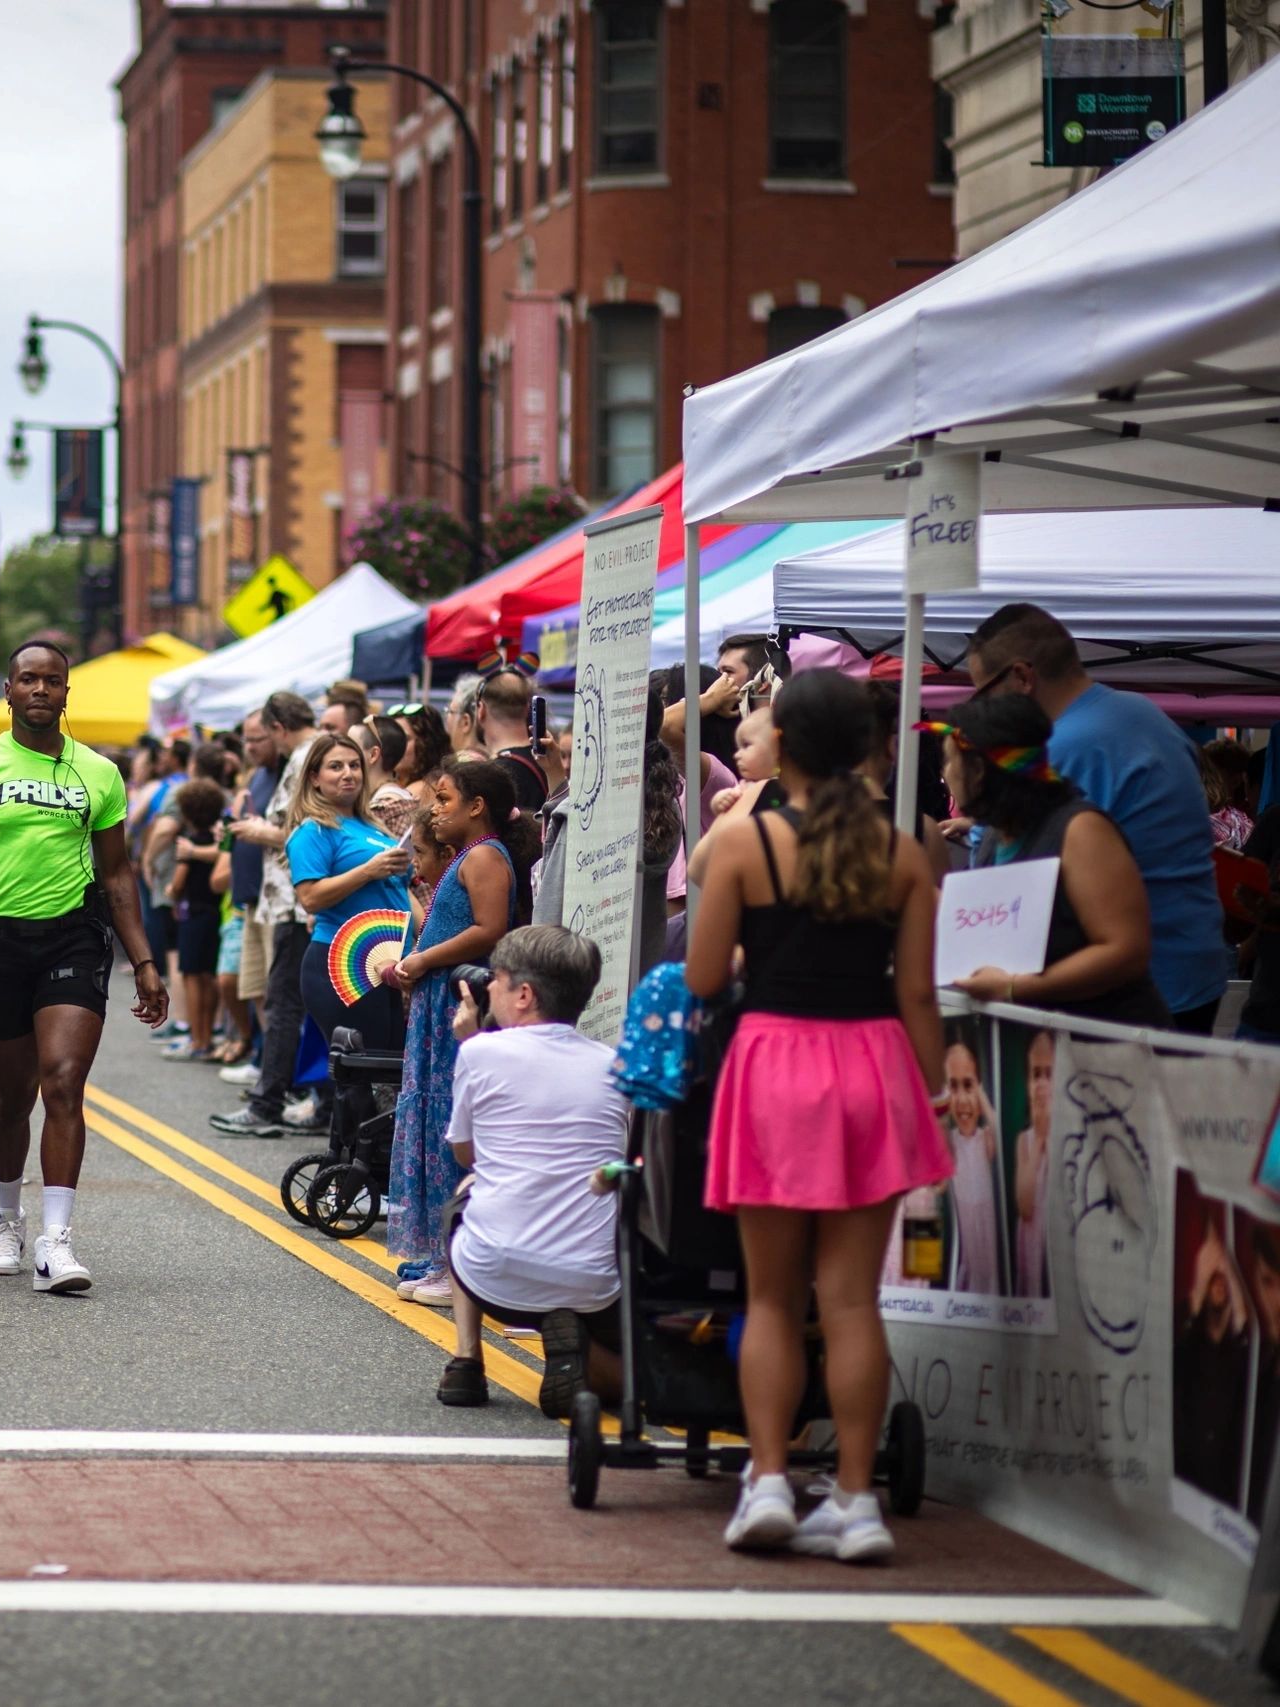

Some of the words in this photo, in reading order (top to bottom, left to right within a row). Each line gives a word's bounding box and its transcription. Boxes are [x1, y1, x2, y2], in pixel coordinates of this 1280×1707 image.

[1098, 93, 1152, 103] Downtown
[1099, 104, 1150, 113] Worcester
[594, 552, 605, 572] NO
[609, 548, 622, 569] EVIL
[625, 539, 654, 565] PROJECT
[589, 624, 607, 646] FOR
[607, 622, 618, 642] THE
[37, 809, 83, 820] WORCESTE
[956, 896, 1022, 931] 30459
[890, 1356, 952, 1420] NO
